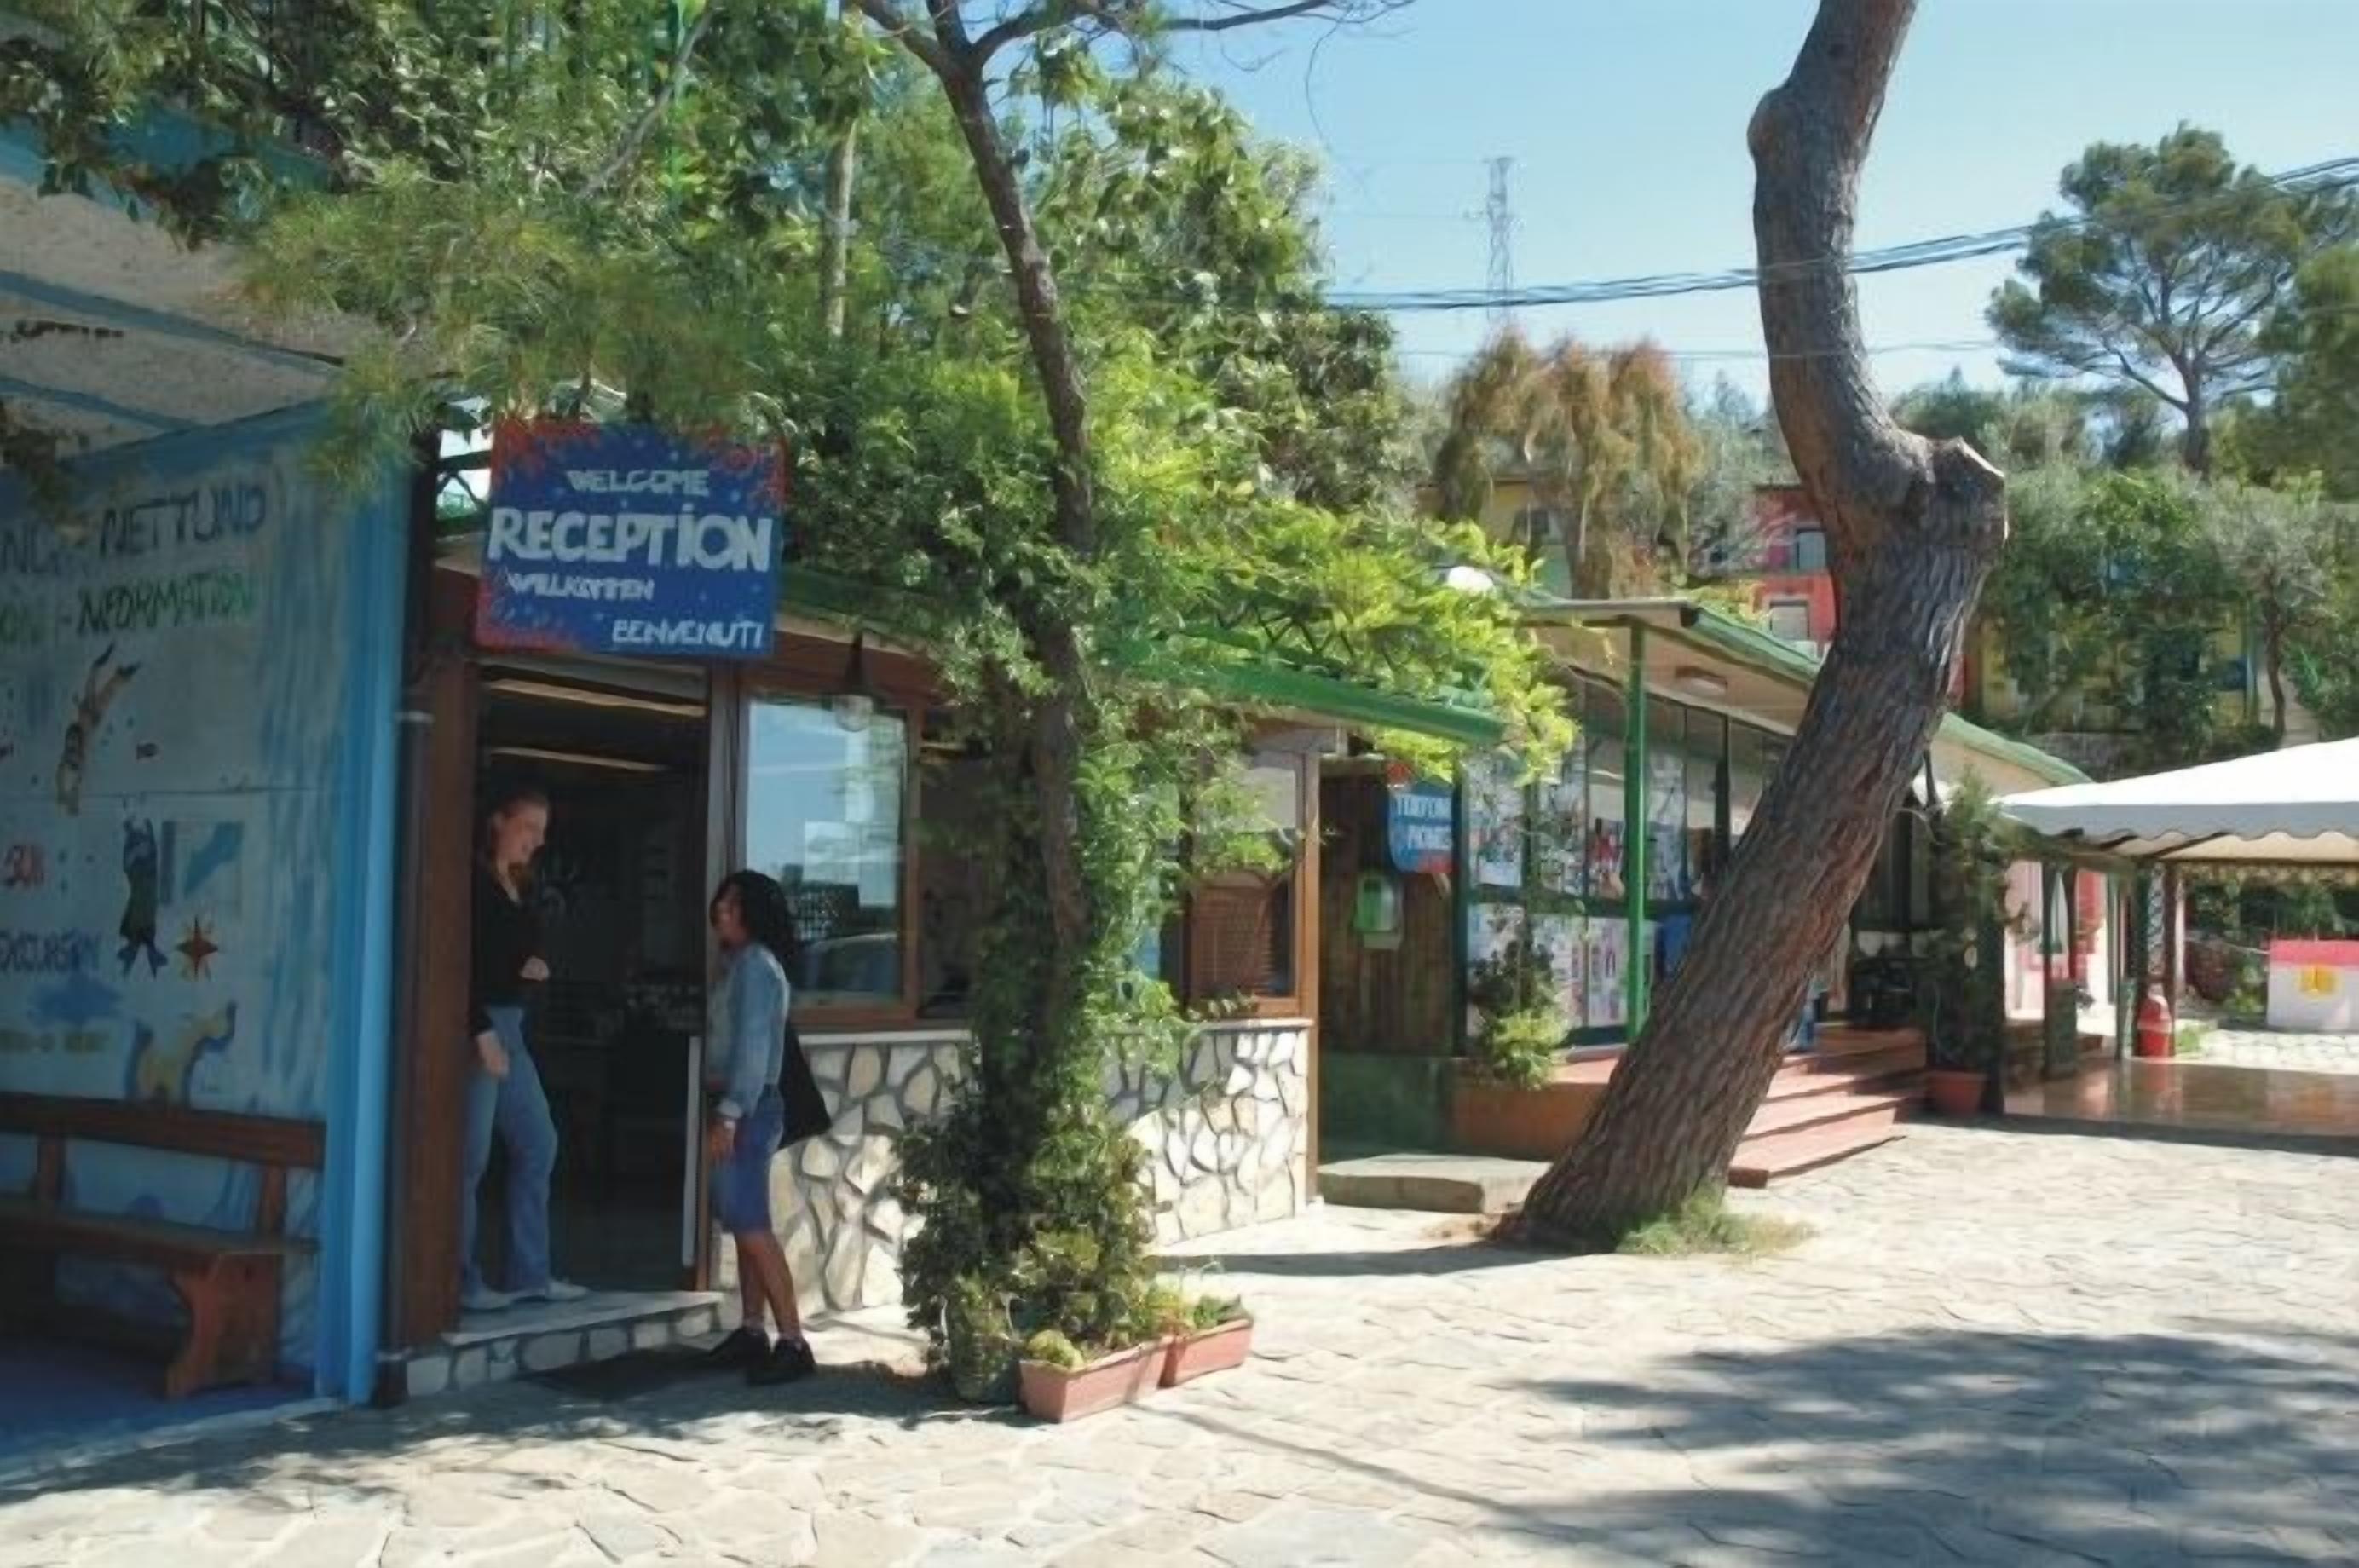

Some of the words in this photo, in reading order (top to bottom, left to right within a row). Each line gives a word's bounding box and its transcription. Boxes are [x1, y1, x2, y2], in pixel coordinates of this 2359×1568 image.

[563, 469, 711, 498] WELCOME
[487, 503, 773, 573] RECEPTION
[613, 618, 764, 649] BENVENUTI
